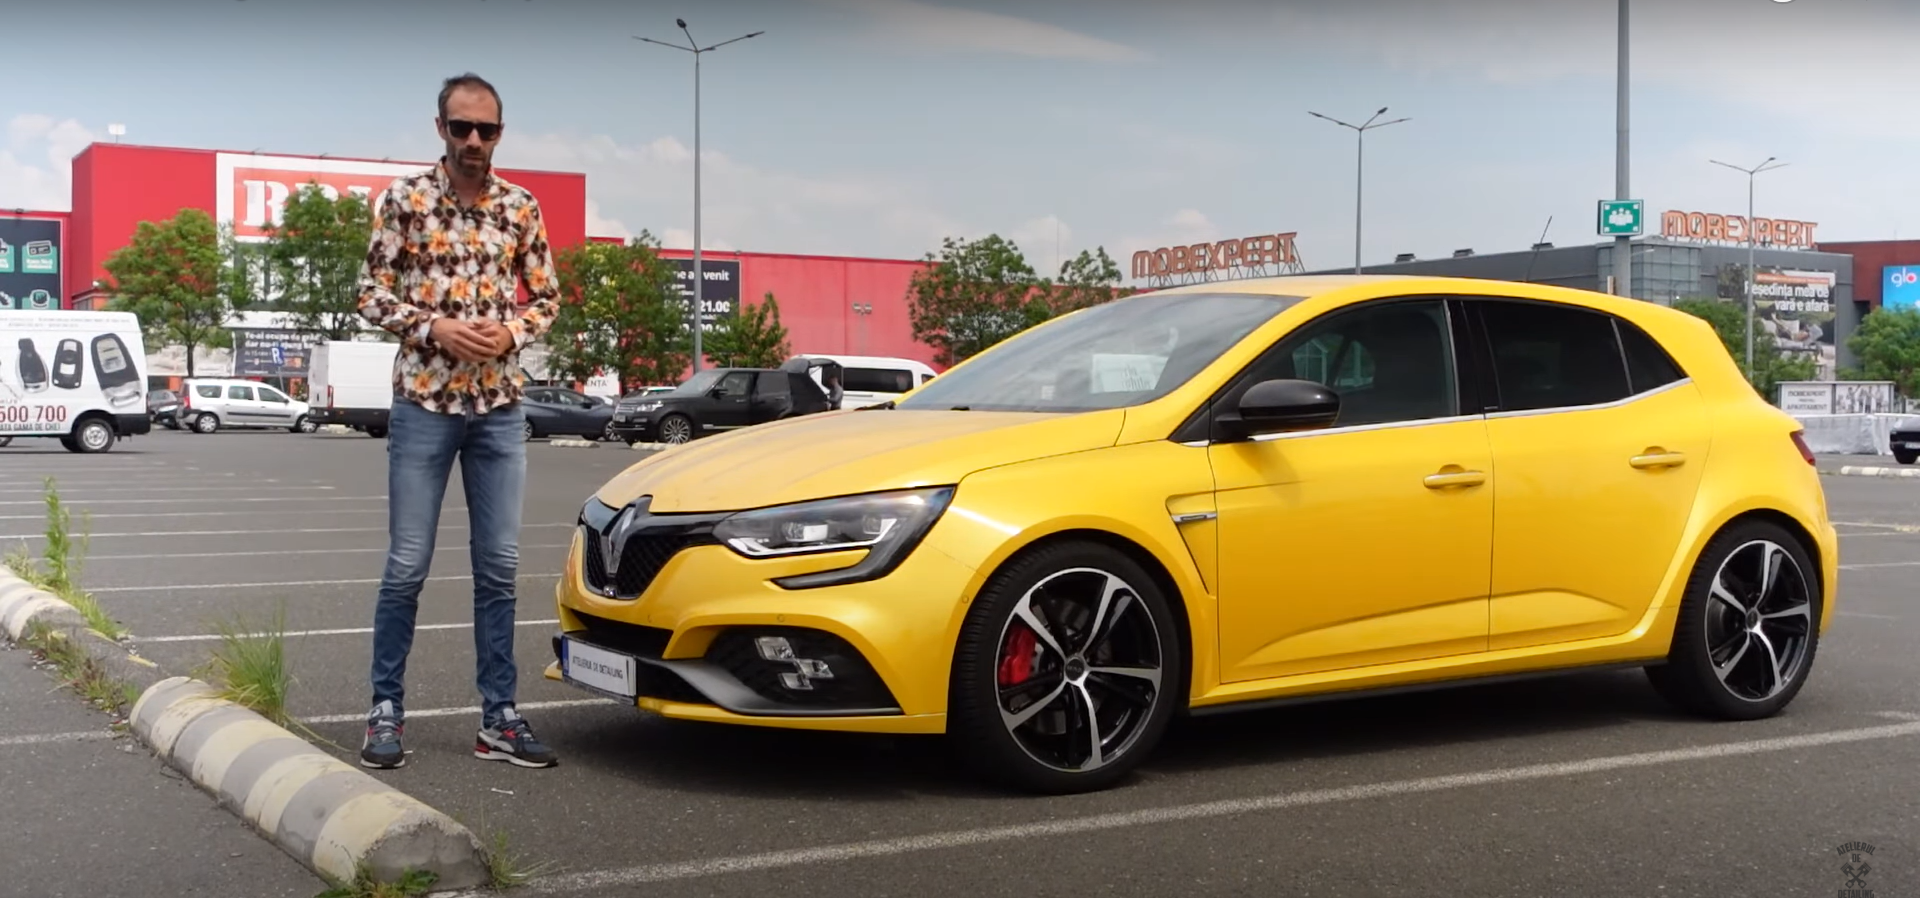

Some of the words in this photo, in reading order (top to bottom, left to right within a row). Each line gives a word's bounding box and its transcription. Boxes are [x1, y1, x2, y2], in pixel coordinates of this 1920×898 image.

[1661, 209, 1818, 248] MOBEXPERT
[1131, 231, 1298, 279] MOBEXPERT
[703, 269, 730, 280] venit
[1891, 266, 1917, 287] glo
[1797, 301, 1804, 311] e
[272, 348, 283, 364] R
[34, 405, 66, 422] 700
